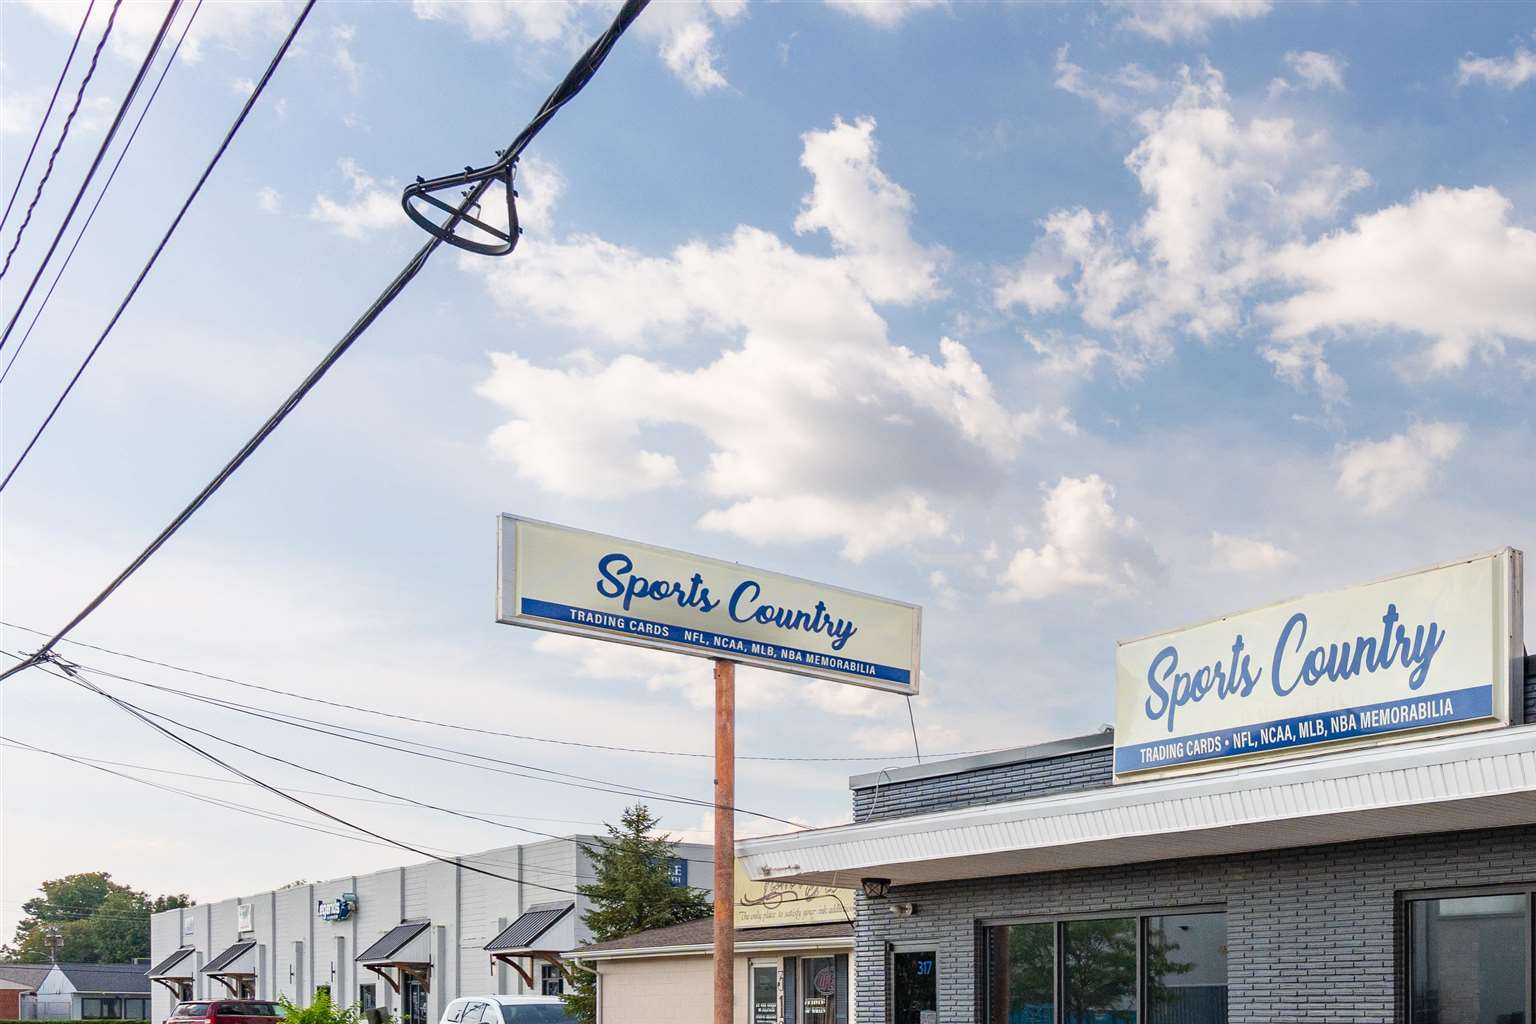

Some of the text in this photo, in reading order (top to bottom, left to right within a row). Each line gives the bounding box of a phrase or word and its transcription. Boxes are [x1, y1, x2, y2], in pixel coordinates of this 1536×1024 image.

[597, 553, 857, 650] Sports Country
[569, 609, 876, 676] TRADING CARDS NFL, NCAA, MLB, NBA MEMORABILIA
[1145, 603, 1446, 732] Sports Country
[1140, 698, 1454, 763] TRADING CARDS NFL, NCAA, MLB, NBA MEMORABILIA
[916, 961, 933, 976] 317
